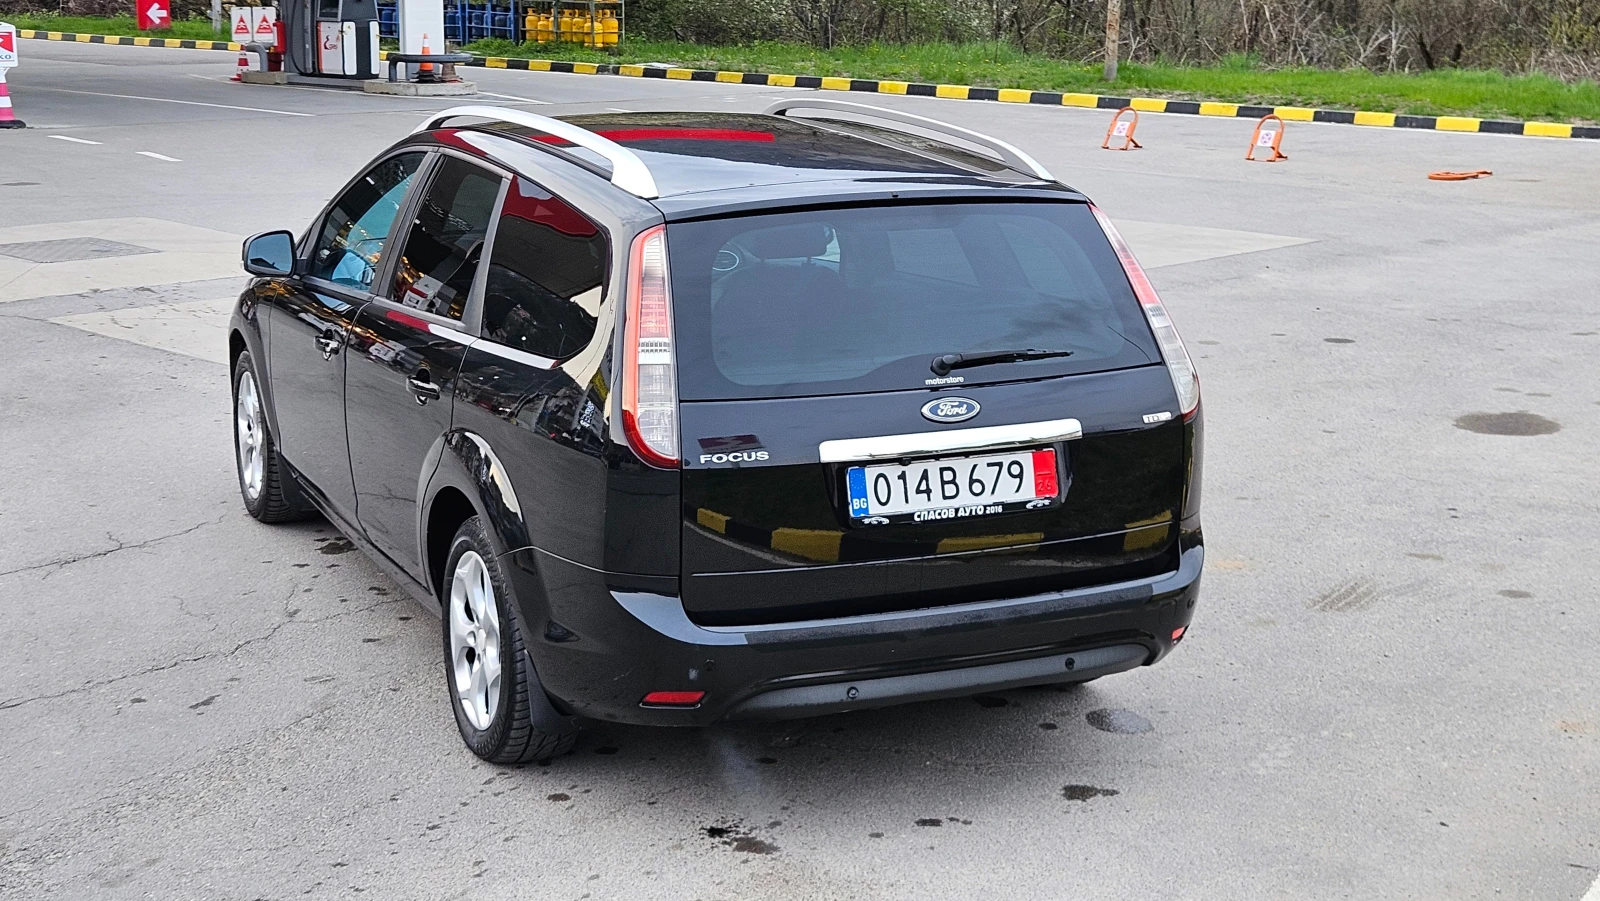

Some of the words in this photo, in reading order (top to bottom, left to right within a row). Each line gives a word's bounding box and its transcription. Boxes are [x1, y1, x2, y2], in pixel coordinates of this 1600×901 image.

[925, 375, 965, 386] motorstore
[937, 401, 967, 416] Ford
[1146, 412, 1169, 422] TD
[699, 451, 770, 465] FOCUS
[853, 497, 867, 510] BG
[914, 507, 955, 522] СПАСОВ
[957, 505, 985, 517] АУТО
[985, 504, 1003, 515] 2016
